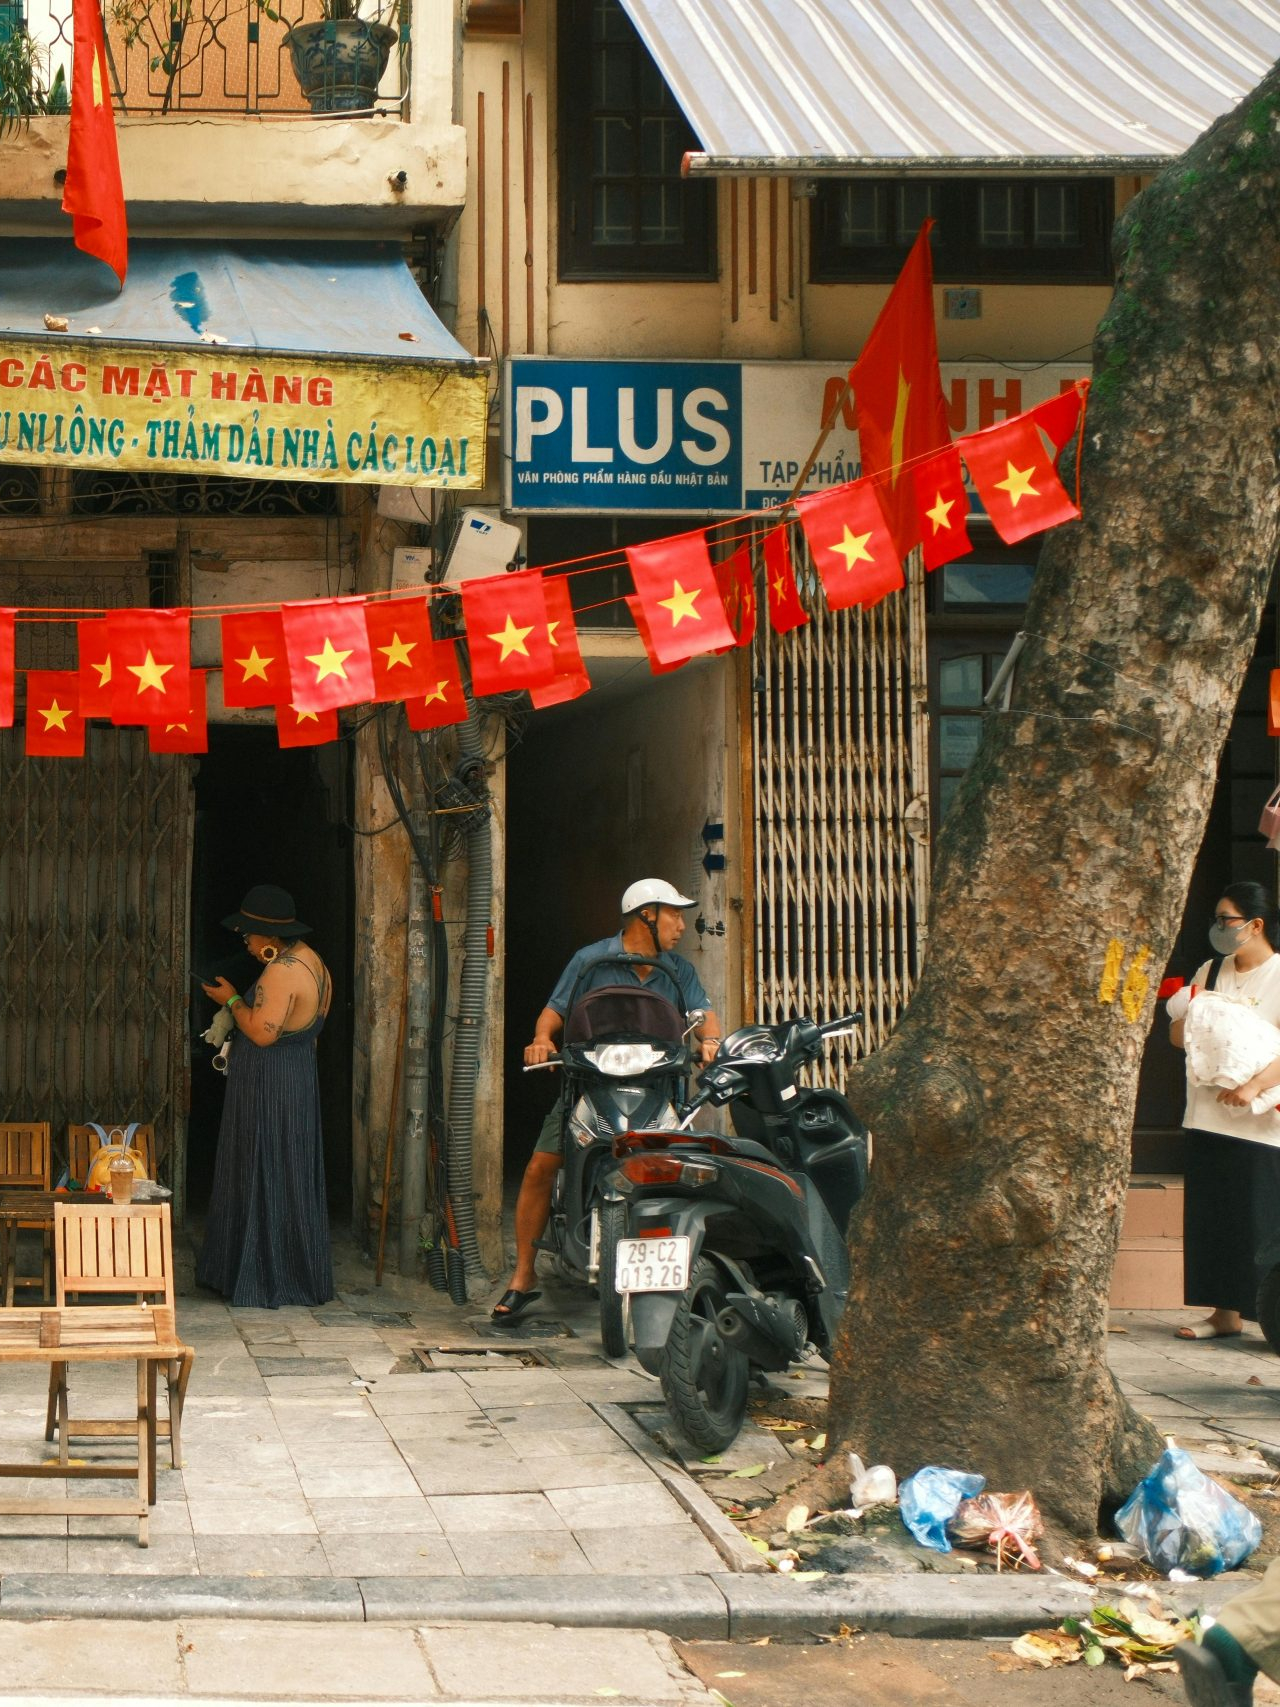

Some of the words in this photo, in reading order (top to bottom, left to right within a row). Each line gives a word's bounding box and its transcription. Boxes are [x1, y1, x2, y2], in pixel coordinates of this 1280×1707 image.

[101, 362, 198, 404] MẶT
[211, 367, 333, 406] HÀNG
[515, 386, 731, 466] PLUS
[282, 419, 339, 470] NHÀ
[346, 421, 398, 473] CÁC
[405, 435, 469, 487] LOẠI
[543, 470, 579, 484] PHÒNG
[617, 470, 646, 485] HÀNG
[760, 461, 798, 488] TẠP
[627, 1241, 677, 1264] 29-C2
